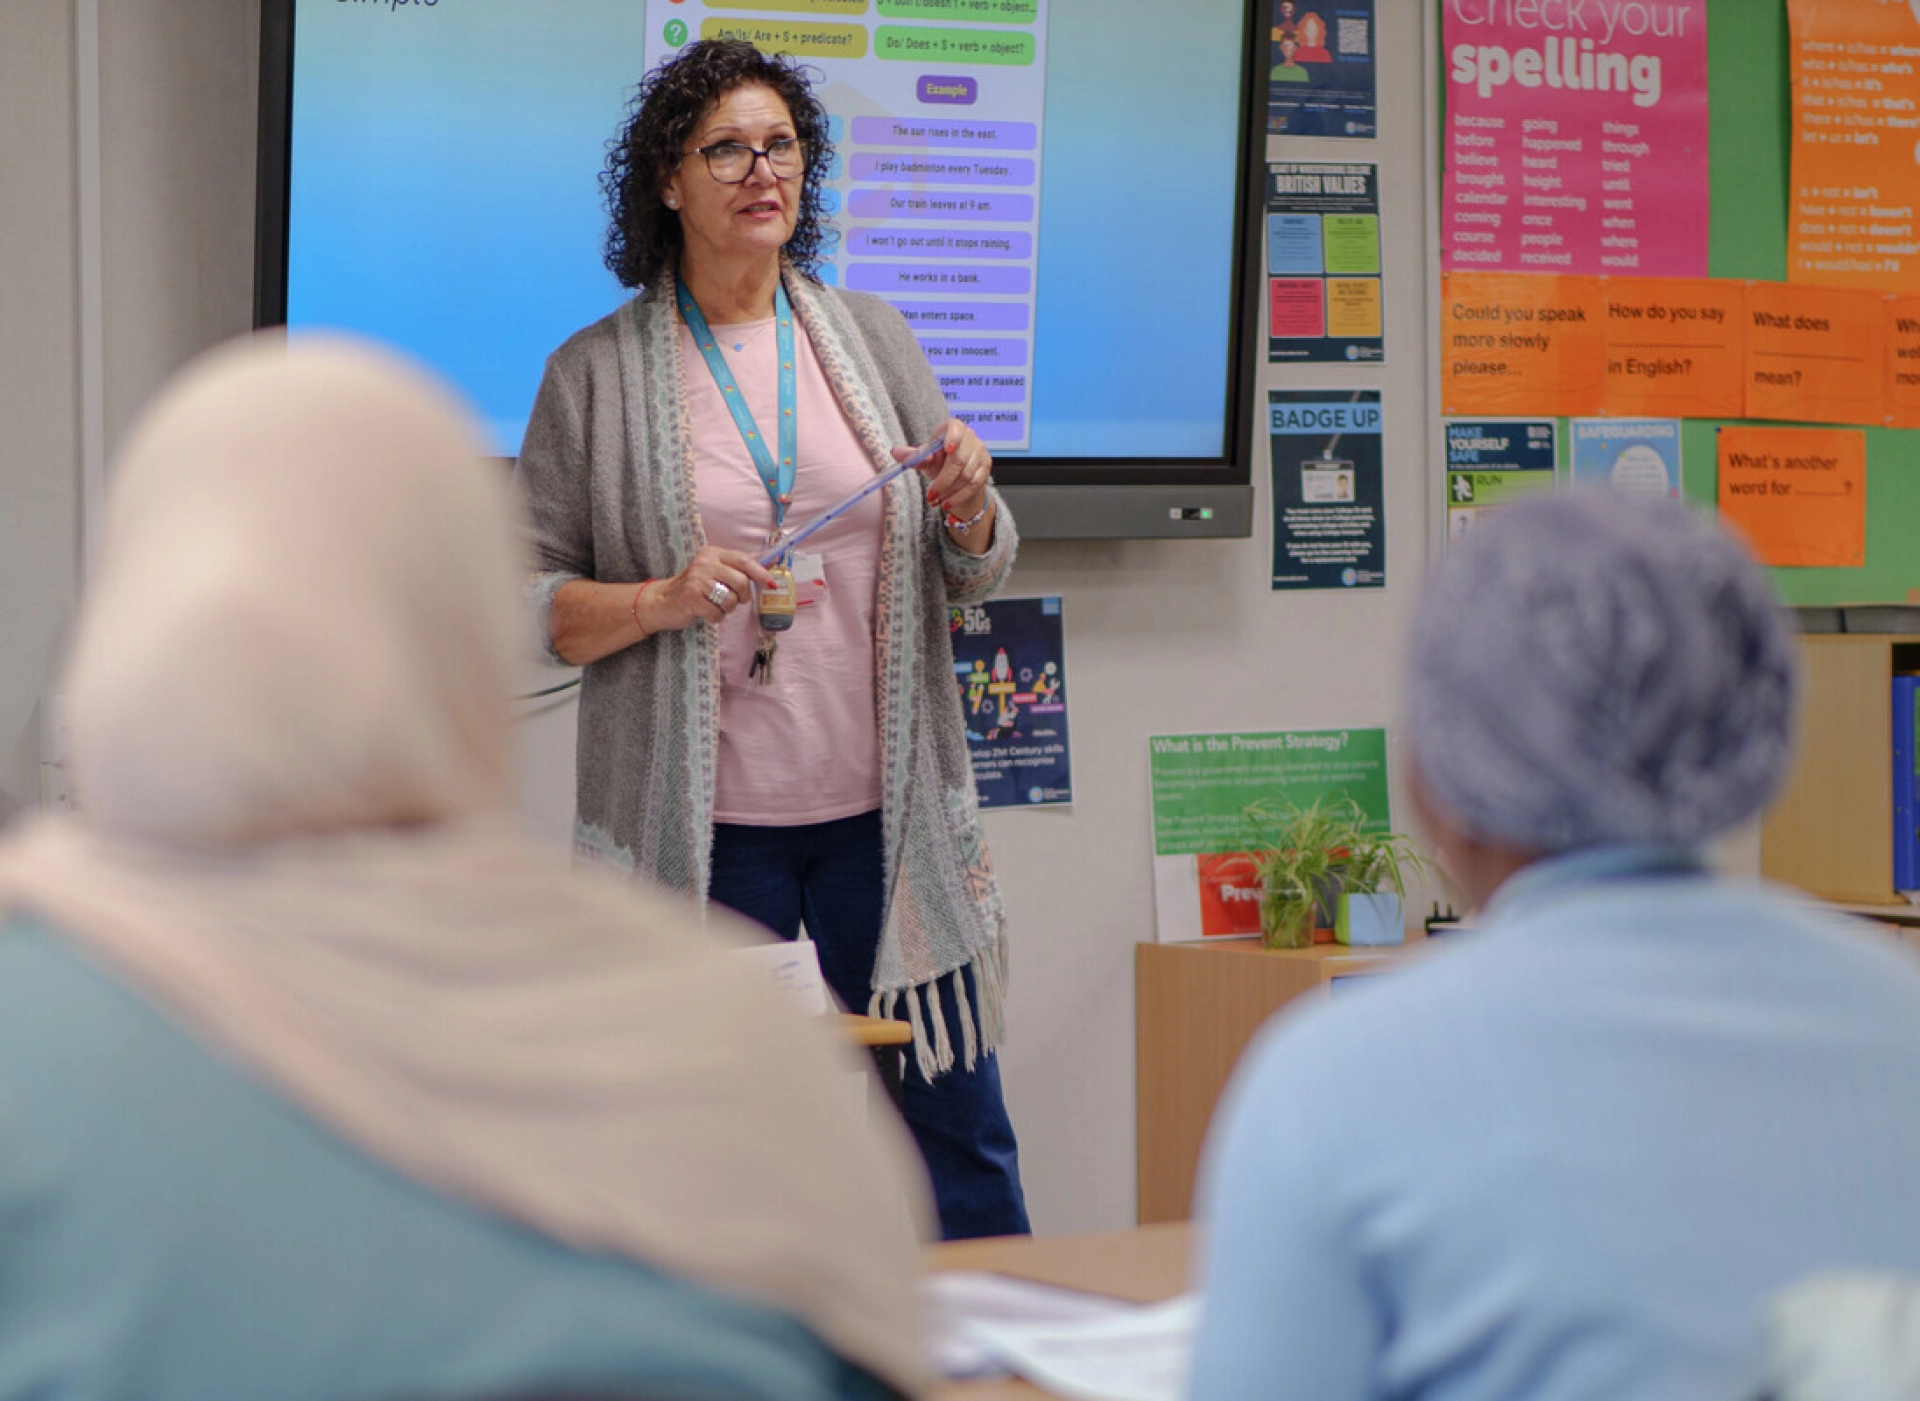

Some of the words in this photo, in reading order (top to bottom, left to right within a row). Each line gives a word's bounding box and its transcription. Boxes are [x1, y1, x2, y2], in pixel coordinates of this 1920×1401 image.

[1599, 1, 1690, 45] your
[906, 38, 930, 50] Does
[941, 39, 948, 51] S
[959, 41, 979, 52] verb
[990, 43, 1025, 56] object?
[1451, 36, 1661, 107] spelling
[926, 83, 968, 98] Example
[1454, 112, 1505, 128] because
[1522, 118, 1558, 134] going
[893, 125, 907, 136] The
[911, 128, 925, 137] sun
[928, 127, 948, 138] rises
[951, 128, 959, 138] in
[962, 128, 974, 139] the
[977, 129, 997, 139] east.
[1602, 121, 1639, 138] things
[1454, 132, 1495, 147] before
[1522, 136, 1582, 152] happened
[1602, 140, 1650, 158] through
[1454, 152, 1498, 166] believe
[1522, 155, 1557, 169] heard
[1602, 160, 1630, 172] tried
[880, 161, 898, 173] play
[901, 162, 946, 173] badminton
[948, 165, 970, 176] every
[974, 164, 1011, 177] Tuesday.
[1276, 174, 1321, 194] BRITISH
[1322, 175, 1367, 195] VALUES
[1455, 171, 1505, 189] brought
[1523, 174, 1561, 191] height
[1602, 178, 1631, 191] until
[890, 198, 904, 209] Our
[908, 198, 926, 209] train
[930, 199, 956, 211] leaves
[959, 201, 967, 211] at
[977, 202, 992, 211] am.
[1523, 193, 1586, 212] interesting
[1454, 210, 1501, 227] coming
[1522, 215, 1553, 226] once
[1602, 215, 1635, 229] when
[871, 236, 895, 246] won't
[897, 238, 907, 249] go
[910, 237, 923, 246] out
[926, 237, 944, 247] until
[947, 238, 953, 247] it
[955, 238, 978, 249] stops
[981, 238, 1011, 250] raining.
[1453, 231, 1494, 243] course
[1521, 233, 1563, 247] people
[1600, 235, 1638, 248] where
[1452, 249, 1501, 263] decided
[1520, 252, 1571, 265] received
[1600, 255, 1639, 267] would
[898, 271, 910, 281] He
[913, 272, 937, 282] works
[940, 273, 948, 282] in
[958, 273, 981, 283] bank.
[1452, 303, 1500, 321] Could
[1504, 307, 1534, 325] you
[1538, 306, 1586, 323] speak
[1608, 303, 1642, 319] How
[1647, 304, 1666, 320] do
[1670, 307, 1696, 323] you
[1701, 308, 1725, 325] say
[1753, 311, 1790, 329] What
[1794, 315, 1830, 332] does
[1453, 333, 1495, 348] more
[1500, 332, 1550, 351] slowly
[928, 348, 942, 357] you
[945, 347, 958, 356] are
[1607, 360, 1622, 374] in
[1626, 358, 1692, 378] English?
[940, 377, 965, 387] opens
[967, 376, 982, 386] and
[992, 376, 1024, 386] masked
[1754, 370, 1802, 386] mean?
[1271, 409, 1346, 429] BADGE
[1353, 409, 1380, 428] UP
[1448, 426, 1482, 438] MAKE
[1578, 425, 1674, 439] SAFEGUARDING
[1449, 437, 1510, 451] YOURSELF
[1449, 451, 1479, 463] SAFE
[1728, 453, 1781, 470] What's
[1785, 454, 1838, 471] another
[1477, 474, 1502, 486] RUN
[1729, 480, 1767, 496] word
[1770, 479, 1792, 496] for
[1009, 745, 1043, 757] Century
[1043, 744, 1065, 754] skills
[1152, 738, 1189, 755] What
[1193, 738, 1203, 753] is
[1207, 736, 1228, 752] the
[1231, 735, 1282, 752] Prevent
[1286, 732, 1349, 752] Strategy?
[1221, 884, 1263, 902] Prev
